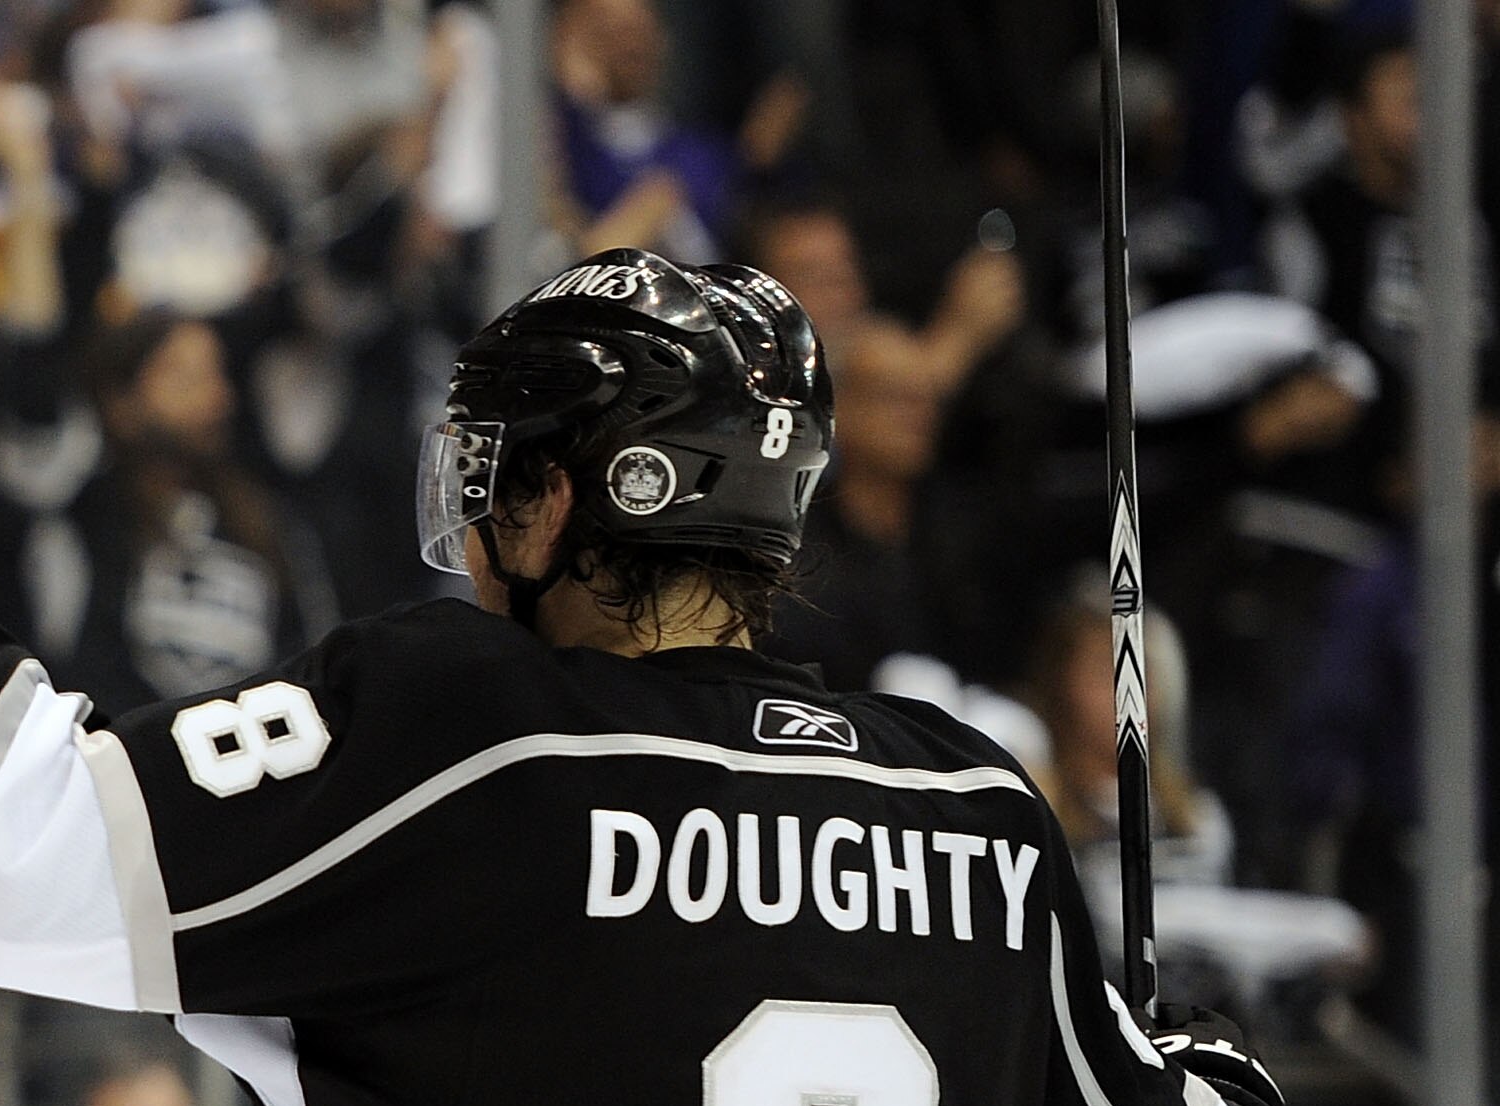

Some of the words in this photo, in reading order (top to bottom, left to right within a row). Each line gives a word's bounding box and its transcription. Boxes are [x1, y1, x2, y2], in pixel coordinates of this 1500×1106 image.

[760, 407, 793, 459] 8
[170, 680, 332, 798] 8
[586, 808, 1040, 951] DOUGHTY
